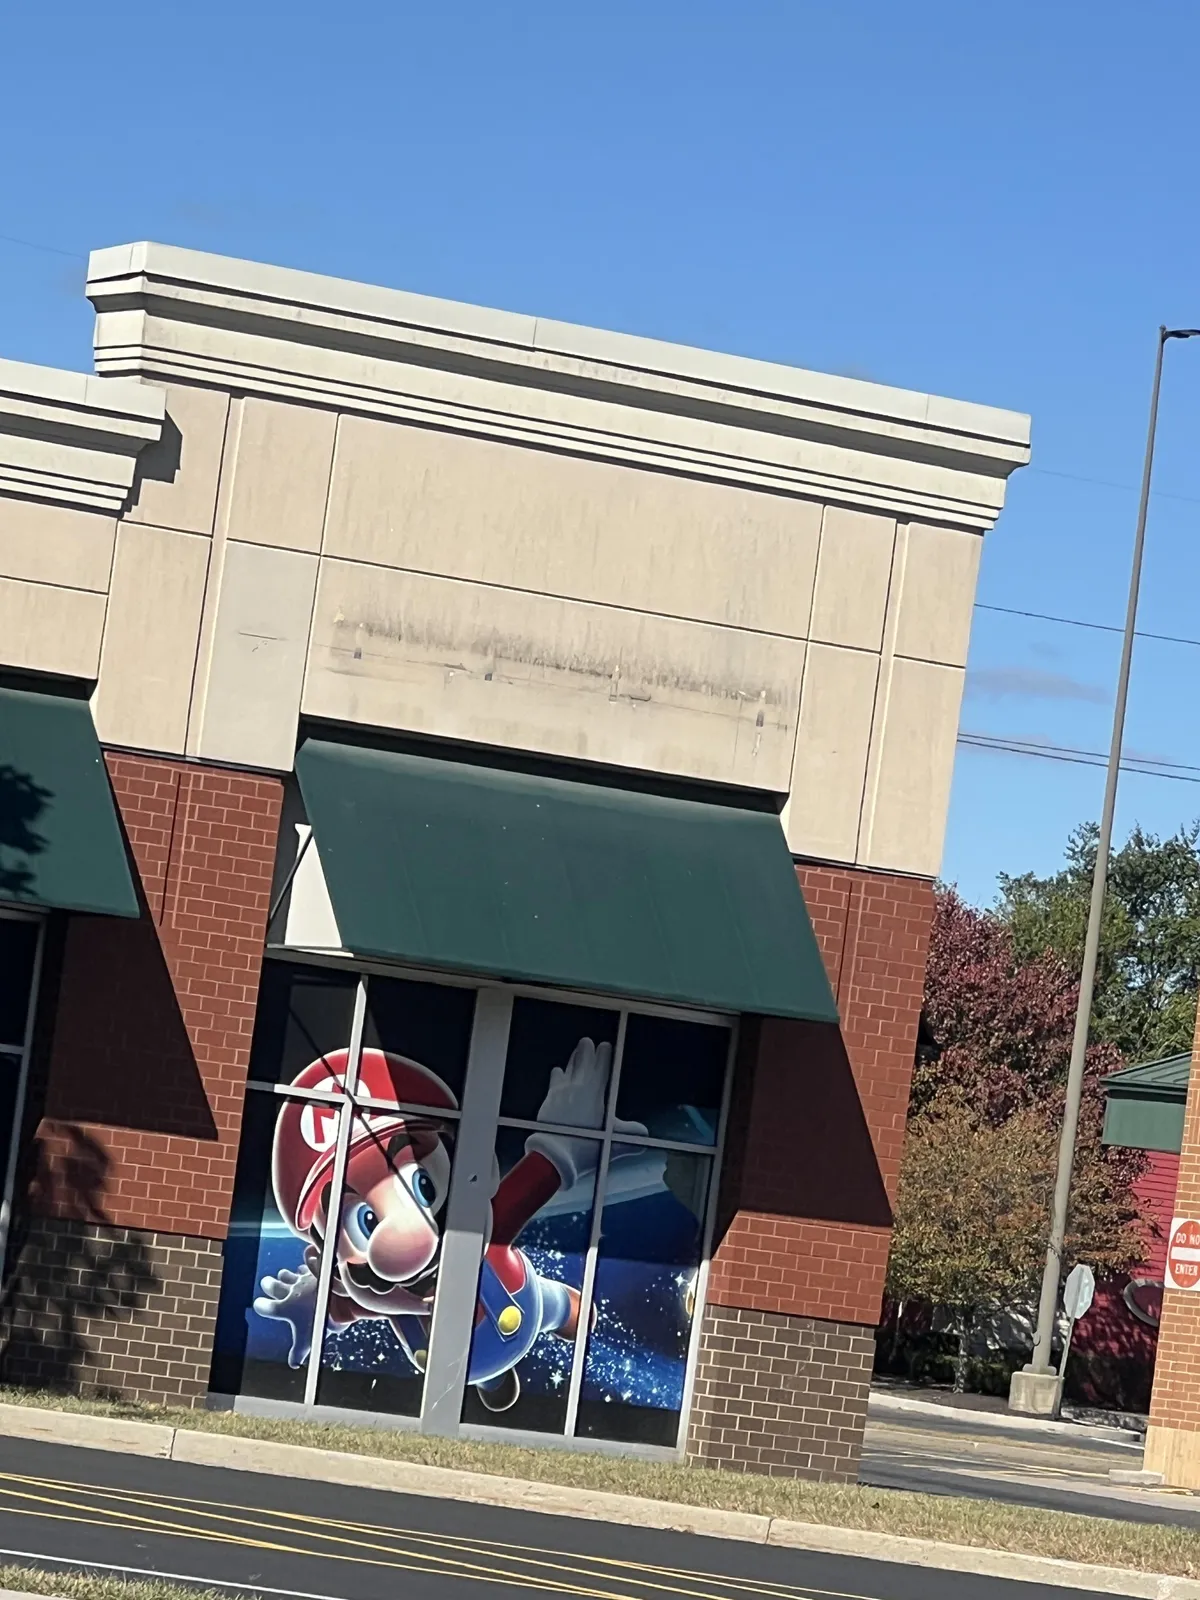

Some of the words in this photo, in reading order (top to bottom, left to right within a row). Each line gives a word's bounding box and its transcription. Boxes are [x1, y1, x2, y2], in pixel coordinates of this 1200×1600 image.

[1175, 1232, 1187, 1244] DO
[1189, 1234, 1200, 1246] NO
[1174, 1263, 1198, 1276] ENTER
